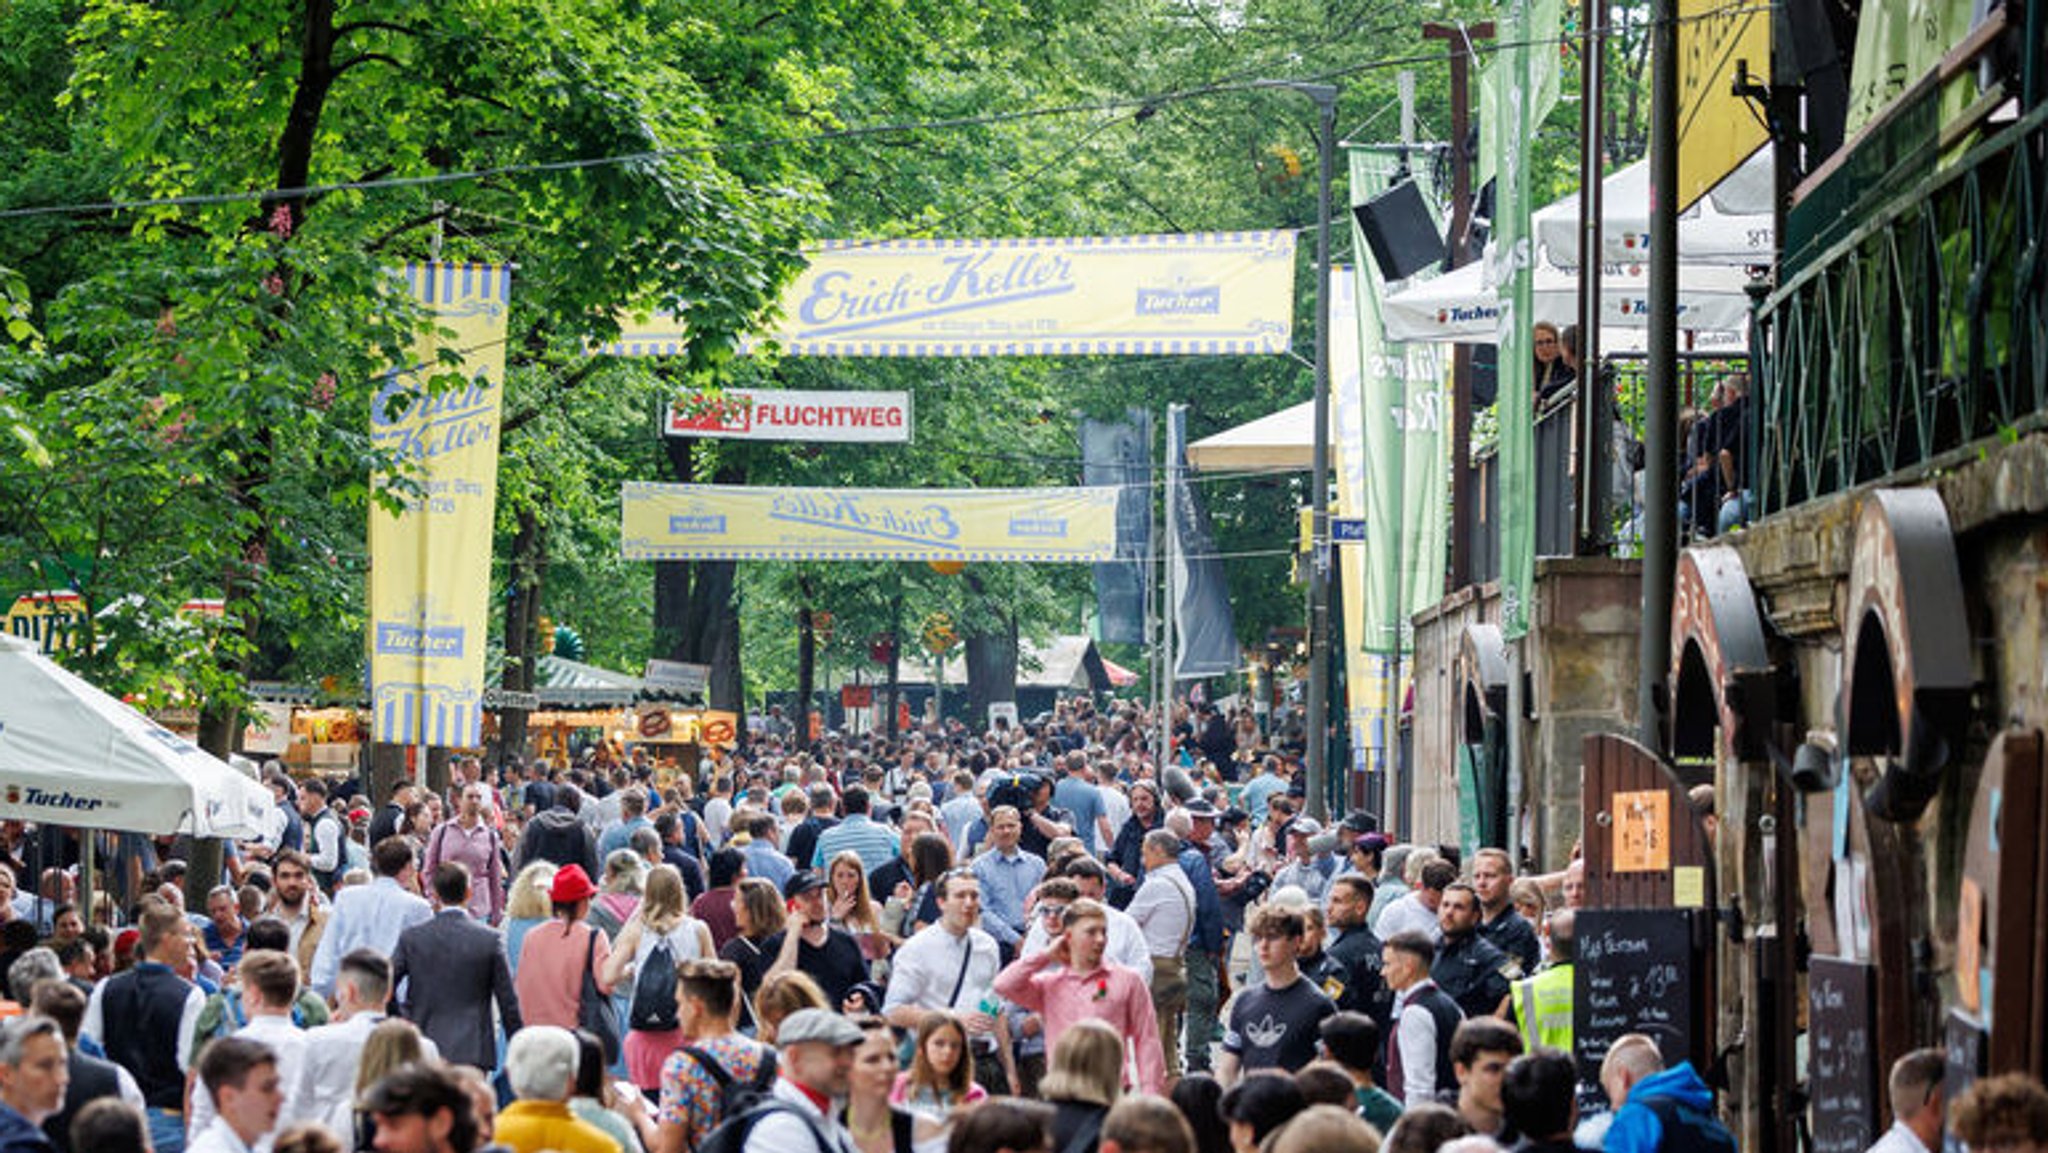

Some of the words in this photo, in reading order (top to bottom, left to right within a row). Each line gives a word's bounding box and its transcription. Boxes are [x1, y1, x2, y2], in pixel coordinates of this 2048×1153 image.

[800, 251, 1071, 325] Erich-Keller
[1144, 293, 1213, 310] Tucher
[756, 404, 903, 427] FLUCHTWEG
[385, 630, 457, 650] Tucher
[25, 787, 103, 811] Tucher
